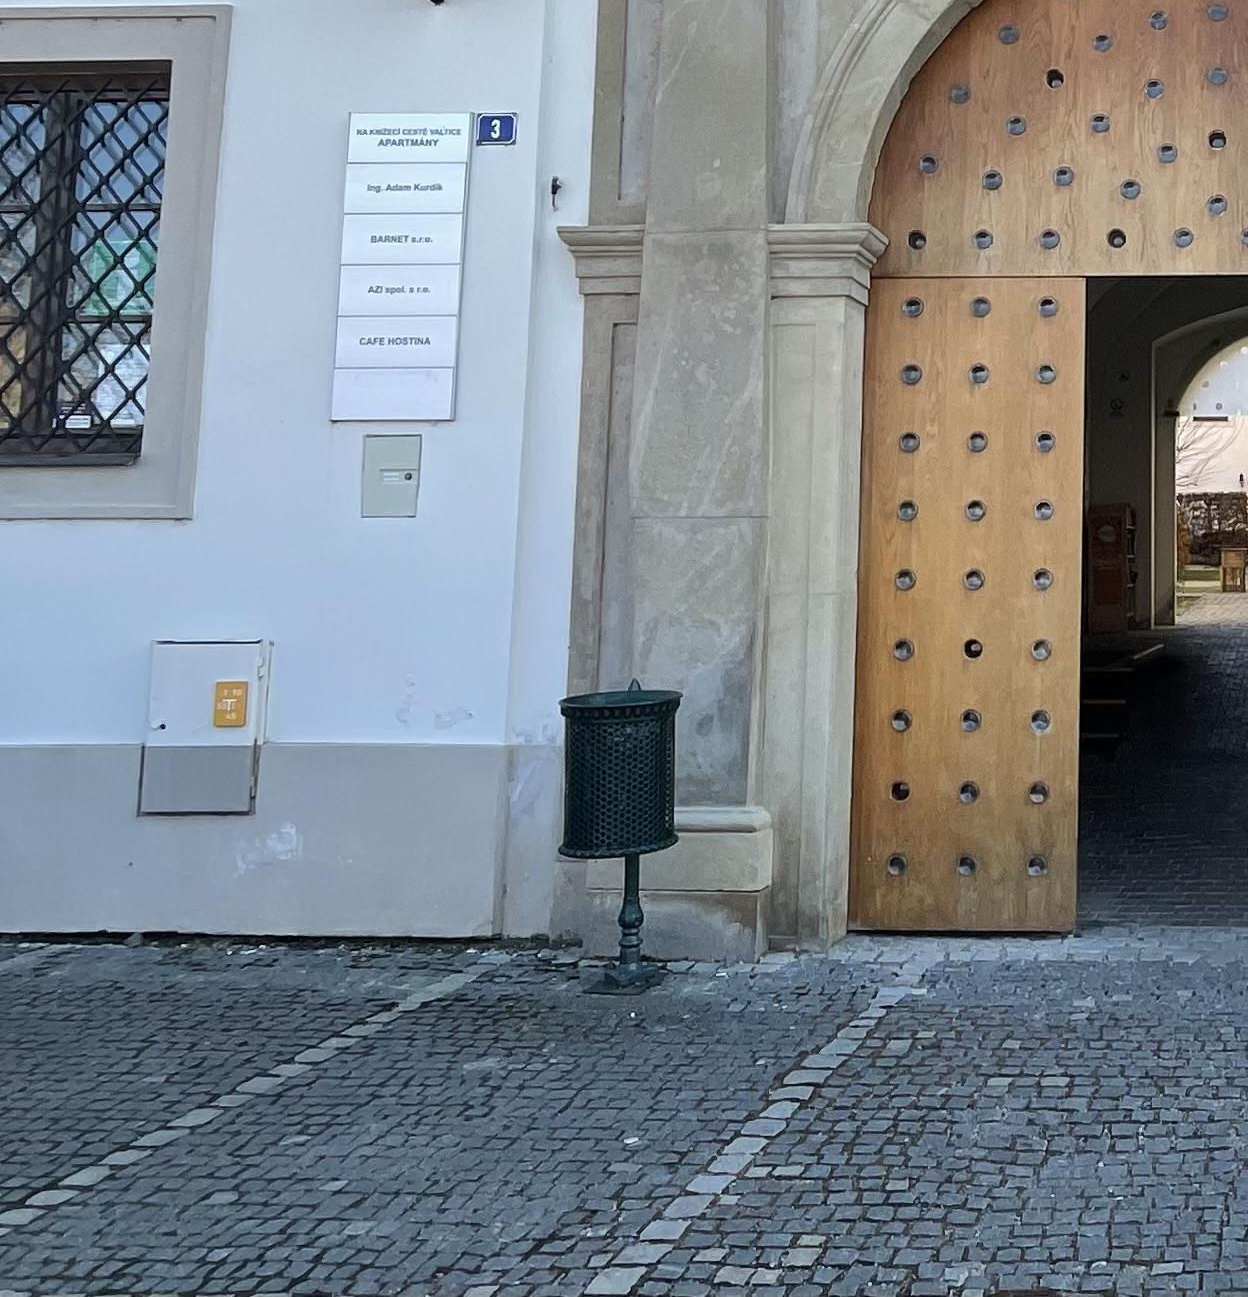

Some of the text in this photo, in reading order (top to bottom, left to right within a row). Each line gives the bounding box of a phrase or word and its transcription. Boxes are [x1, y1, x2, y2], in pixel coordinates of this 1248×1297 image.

[356, 128, 368, 136] NA
[430, 128, 461, 136] VALTICE
[490, 118, 501, 139] 3
[377, 136, 439, 147] APARTMÁNY
[367, 183, 384, 193] Ing.
[385, 183, 411, 191] Adam
[370, 235, 433, 243] BARNET s.r.o.
[367, 286, 383, 294] AZI
[385, 286, 406, 295] spol.
[359, 337, 431, 346] CAFE HOSTINA
